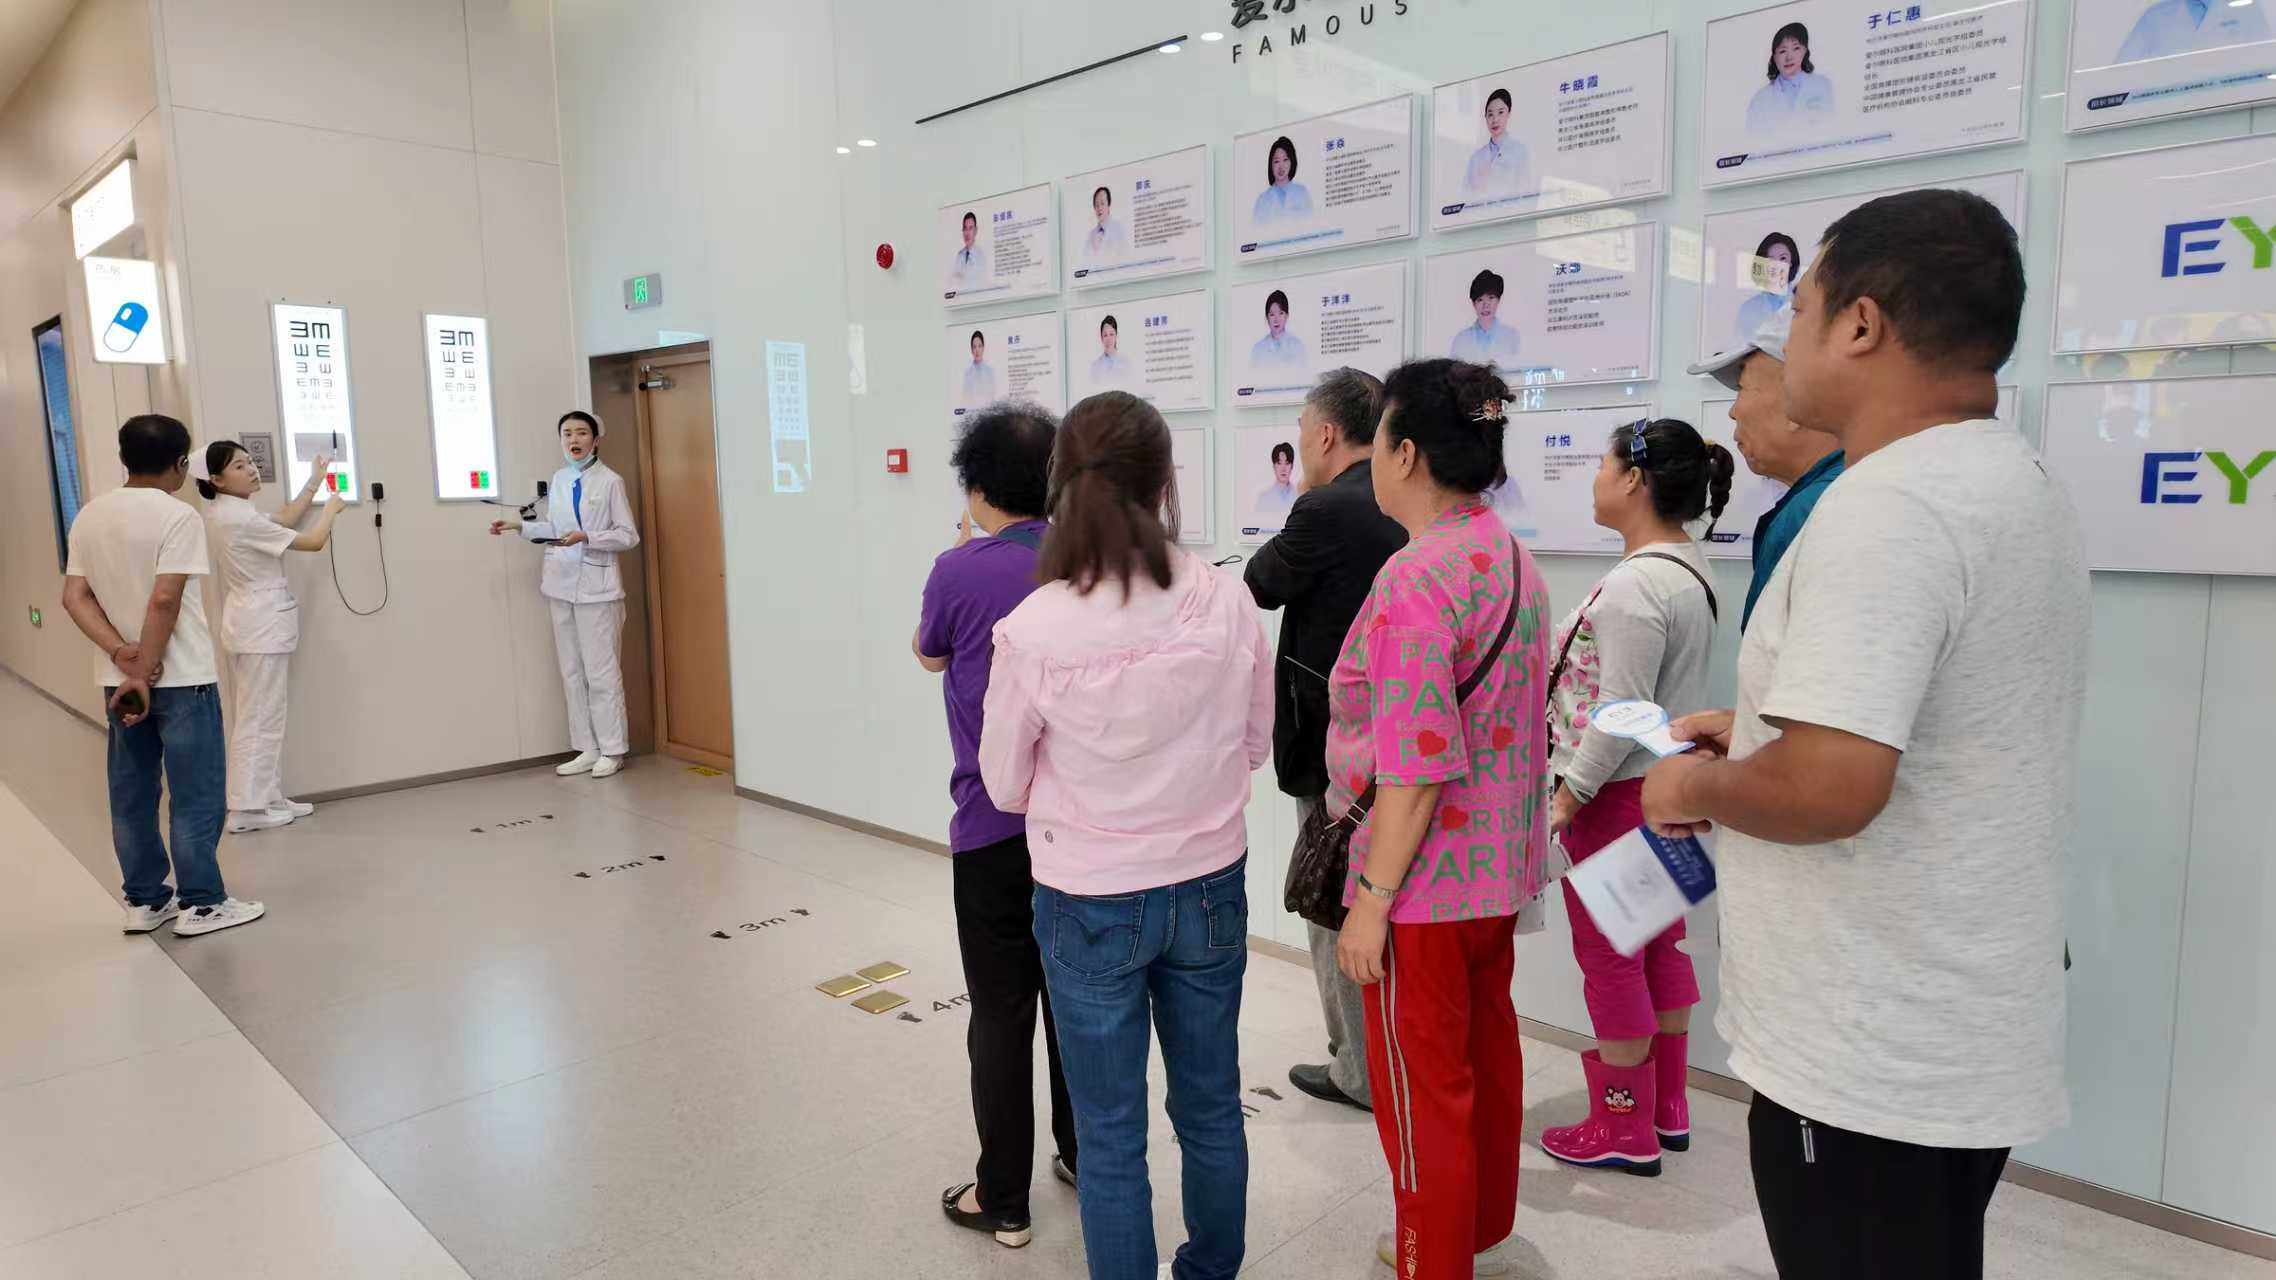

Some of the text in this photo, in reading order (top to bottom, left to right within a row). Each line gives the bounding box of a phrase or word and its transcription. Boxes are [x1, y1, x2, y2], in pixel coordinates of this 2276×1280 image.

[1867, 5, 1921, 29] 于仁惠
[1232, 0, 1408, 64] FAMOUS
[1559, 75, 1599, 94] 牛晓霞
[1545, 434, 1571, 448] 付悦
[601, 860, 643, 874] 2m
[739, 916, 787, 933] 3m
